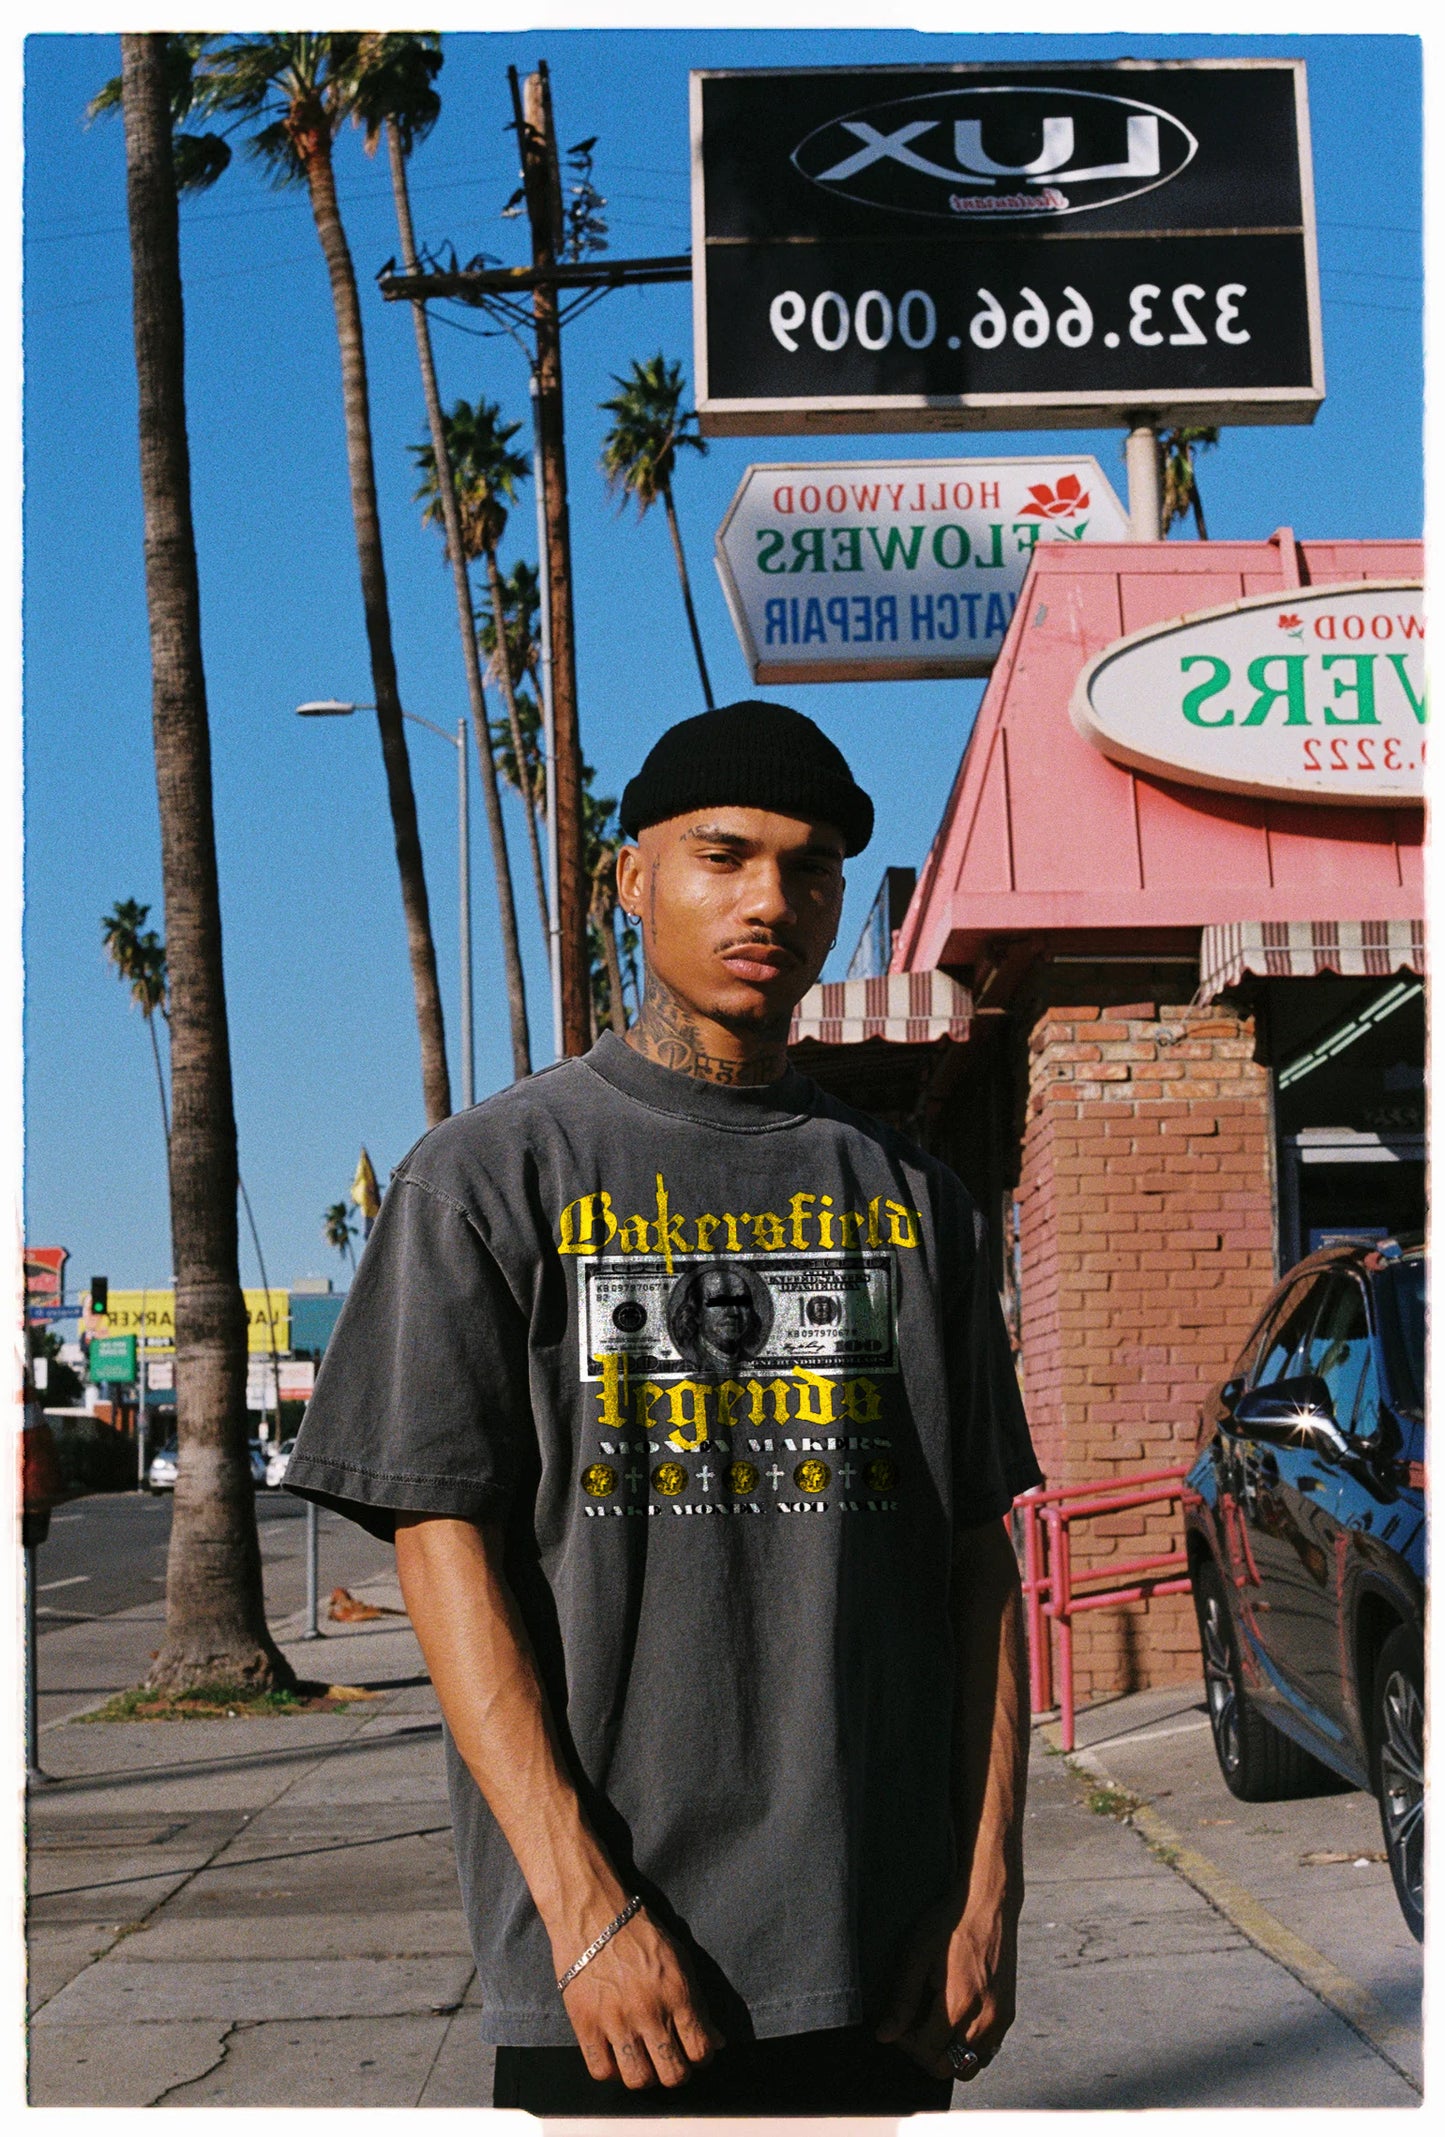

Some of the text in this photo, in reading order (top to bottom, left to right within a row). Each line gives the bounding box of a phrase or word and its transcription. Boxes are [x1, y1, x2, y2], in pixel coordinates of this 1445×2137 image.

[557, 1172, 923, 1276] Bakersfield
[746, 1436, 893, 1453] MAKERS
[584, 1504, 662, 1518] MAKE
[776, 1501, 829, 1514] NOT
